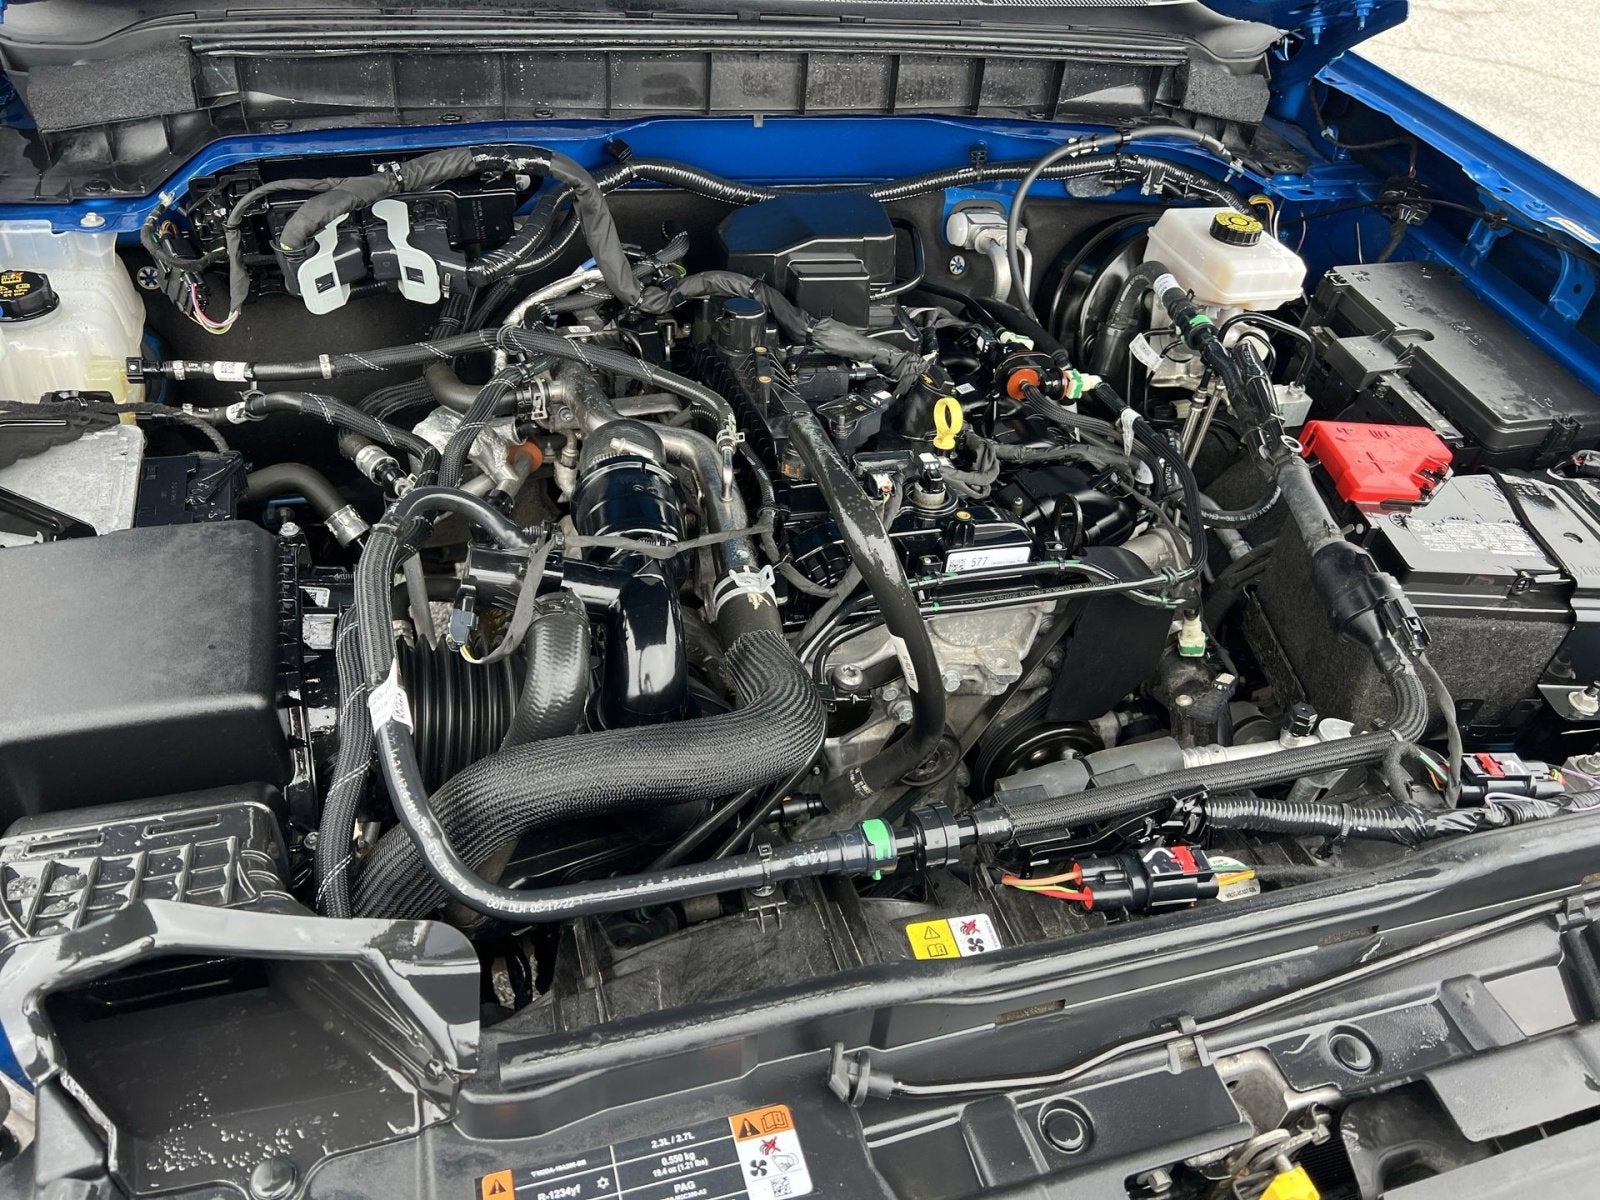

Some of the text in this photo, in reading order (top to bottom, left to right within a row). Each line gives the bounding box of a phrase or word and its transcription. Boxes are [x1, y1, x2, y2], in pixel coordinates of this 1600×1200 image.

[970, 556, 989, 568] 577
[651, 1138, 671, 1149] 2.3L
[675, 1131, 695, 1143] 2.7L
[652, 1157, 709, 1177] 19.4 oz (1.21 lbs)
[661, 1151, 696, 1167] 0.550 kg
[537, 1183, 581, 1200] R-1234yf
[674, 1180, 696, 1193] PAG
